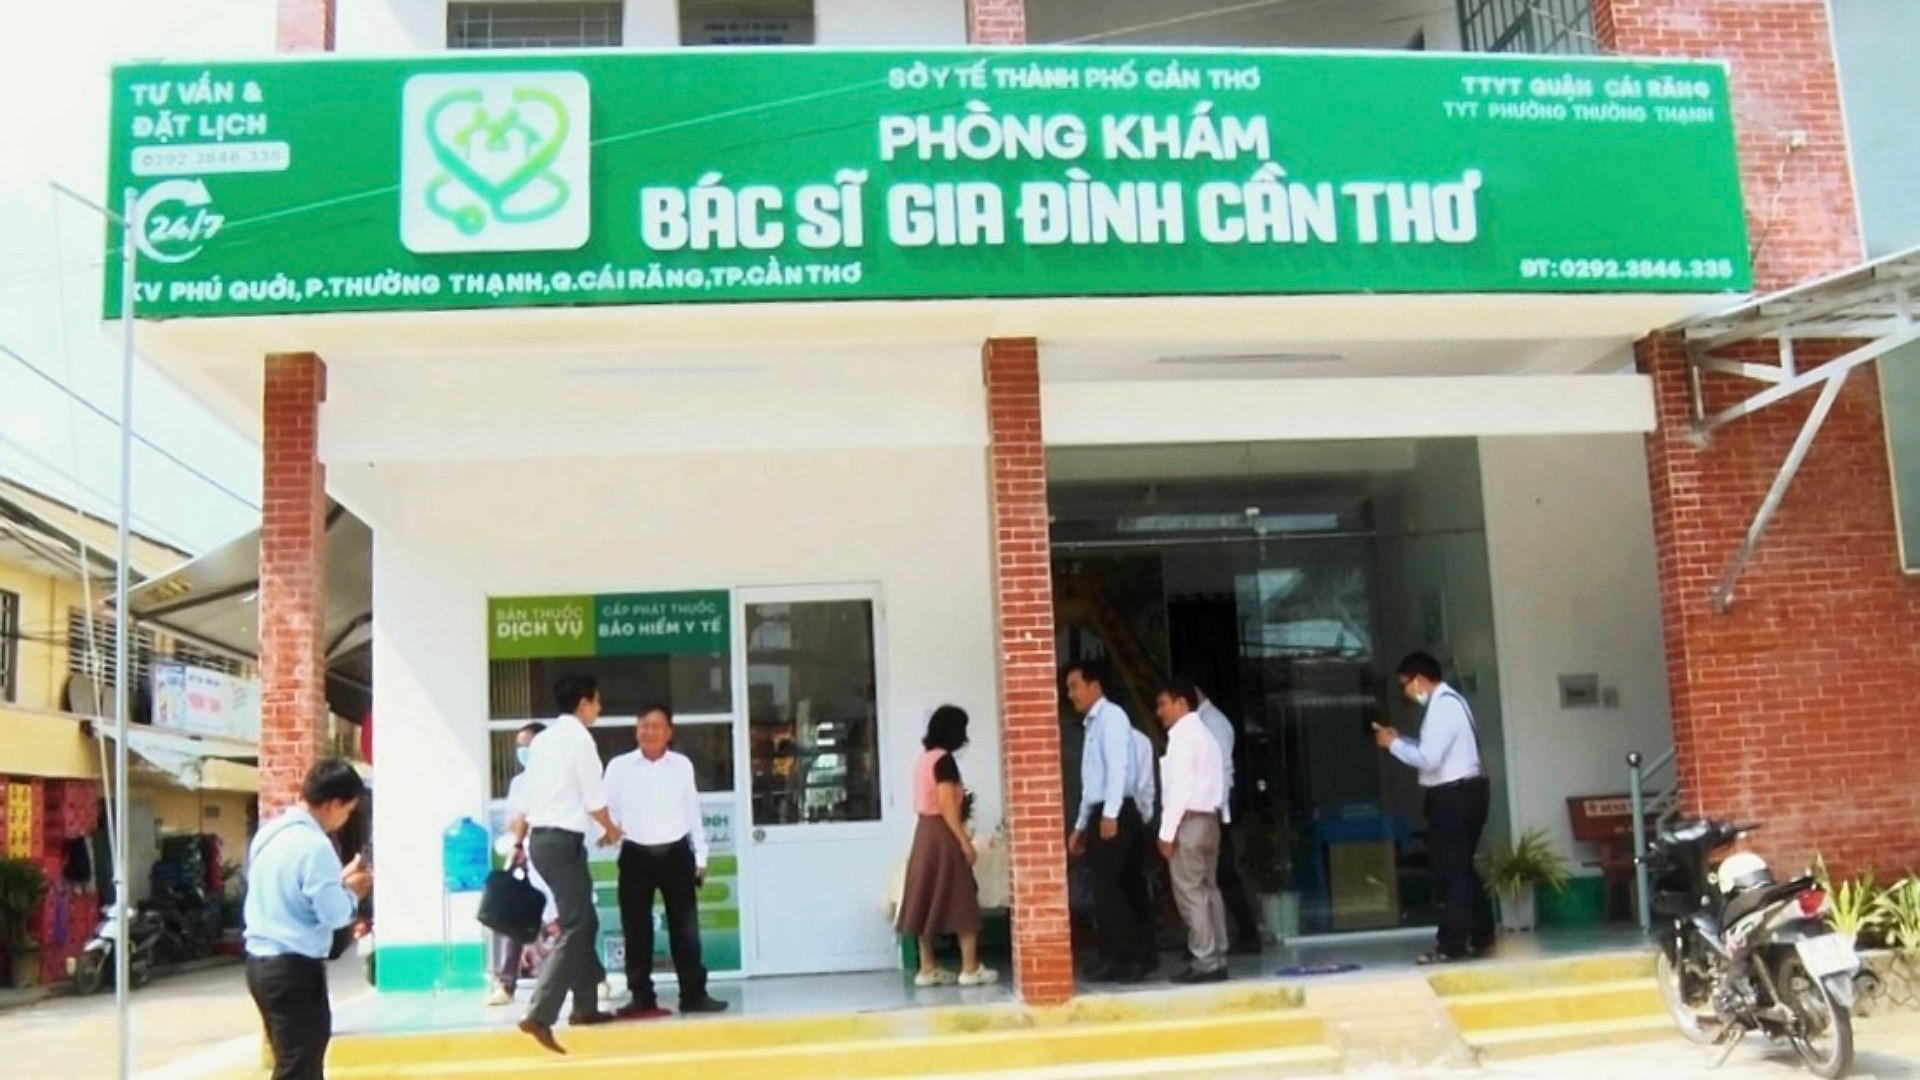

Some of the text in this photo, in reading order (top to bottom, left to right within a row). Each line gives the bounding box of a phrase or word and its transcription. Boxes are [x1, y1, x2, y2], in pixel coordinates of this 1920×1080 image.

[131, 71, 263, 107] TƯ VẤN &
[888, 57, 1261, 90] SỞ Y TẾ THÀNH PHỐ CẦN THƠ
[1461, 73, 1711, 101] TTYT QUẬN CÁI RĂNG
[131, 109, 267, 143] ĐẶT LỊCH
[1442, 100, 1480, 118] TYT
[1488, 97, 1569, 120] PHƯỜNG
[1572, 100, 1647, 122] THƯỜNG
[878, 99, 1271, 161] PHÒNG KHÁM
[641, 160, 1482, 251] BÁC SĨ GIA ĐÌNH CẦN THƠ
[149, 210, 224, 243] 24/7
[169, 274, 223, 302] PHÚ
[804, 261, 863, 284] THƠ
[497, 619, 584, 641] DỊCH VỤ
[684, 620, 696, 633] Y
[701, 614, 722, 634] TẾ
